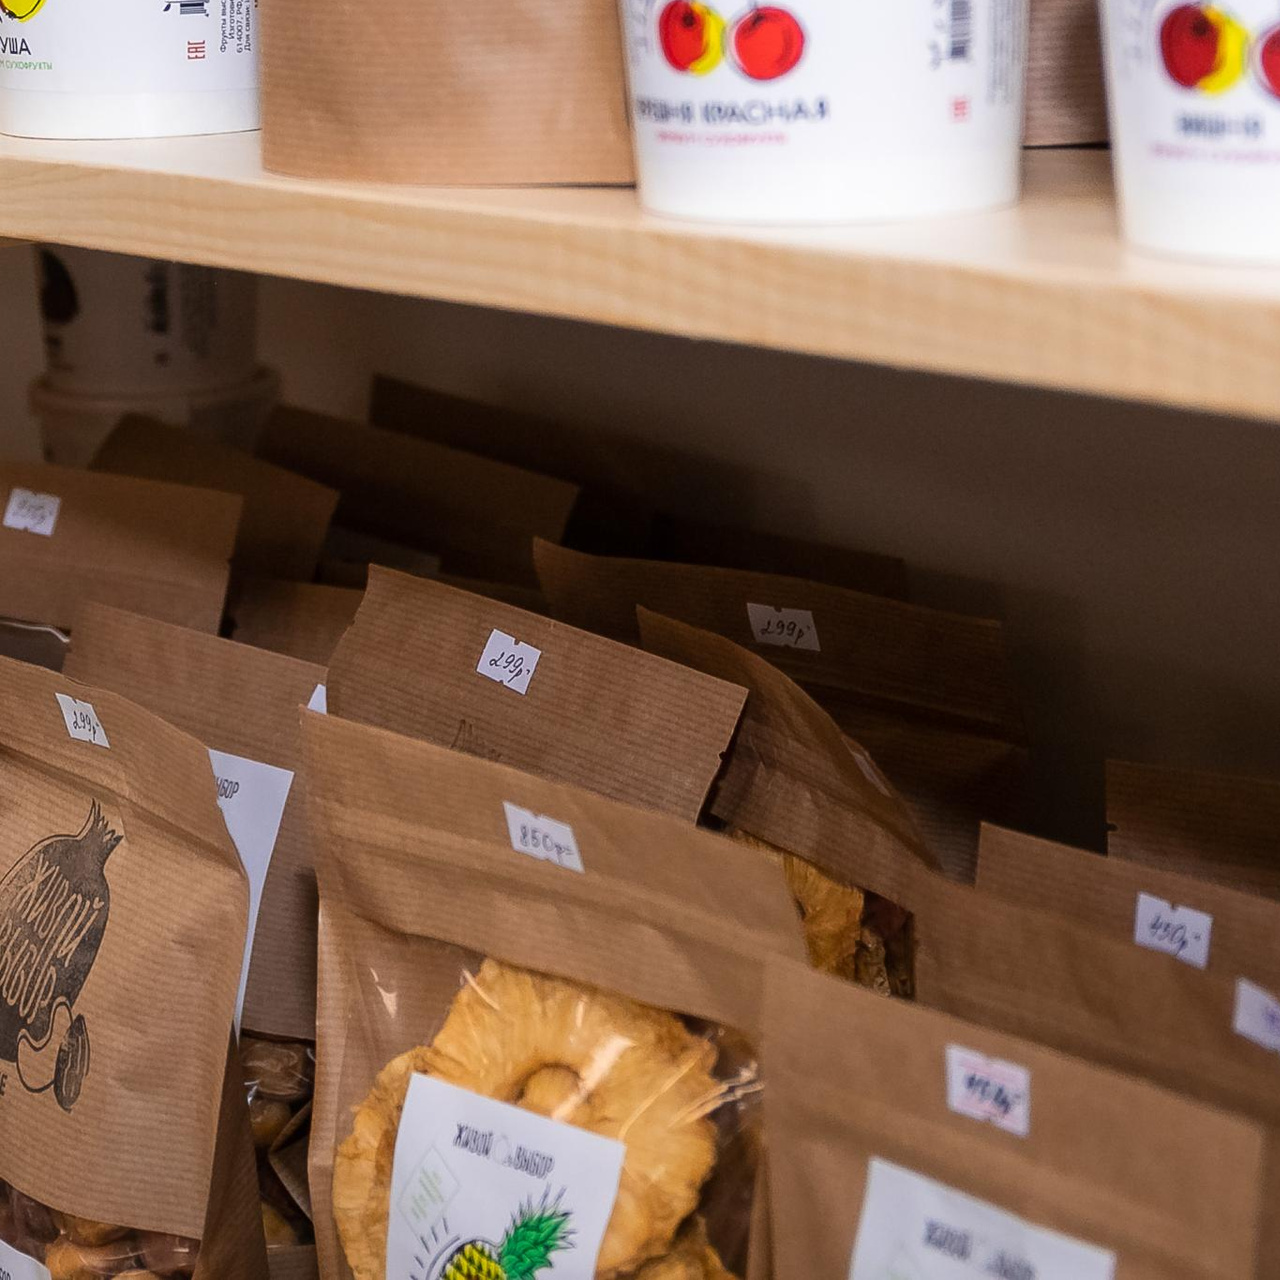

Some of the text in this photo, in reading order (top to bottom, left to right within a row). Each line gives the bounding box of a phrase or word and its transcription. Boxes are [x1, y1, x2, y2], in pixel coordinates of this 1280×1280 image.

[236, 0, 244, 15] РФ,
[220, 18, 228, 53] Фрукты
[5, 60, 53, 70] СУХОФРУКТЫ
[216, 777, 240, 799] ЫБОР
